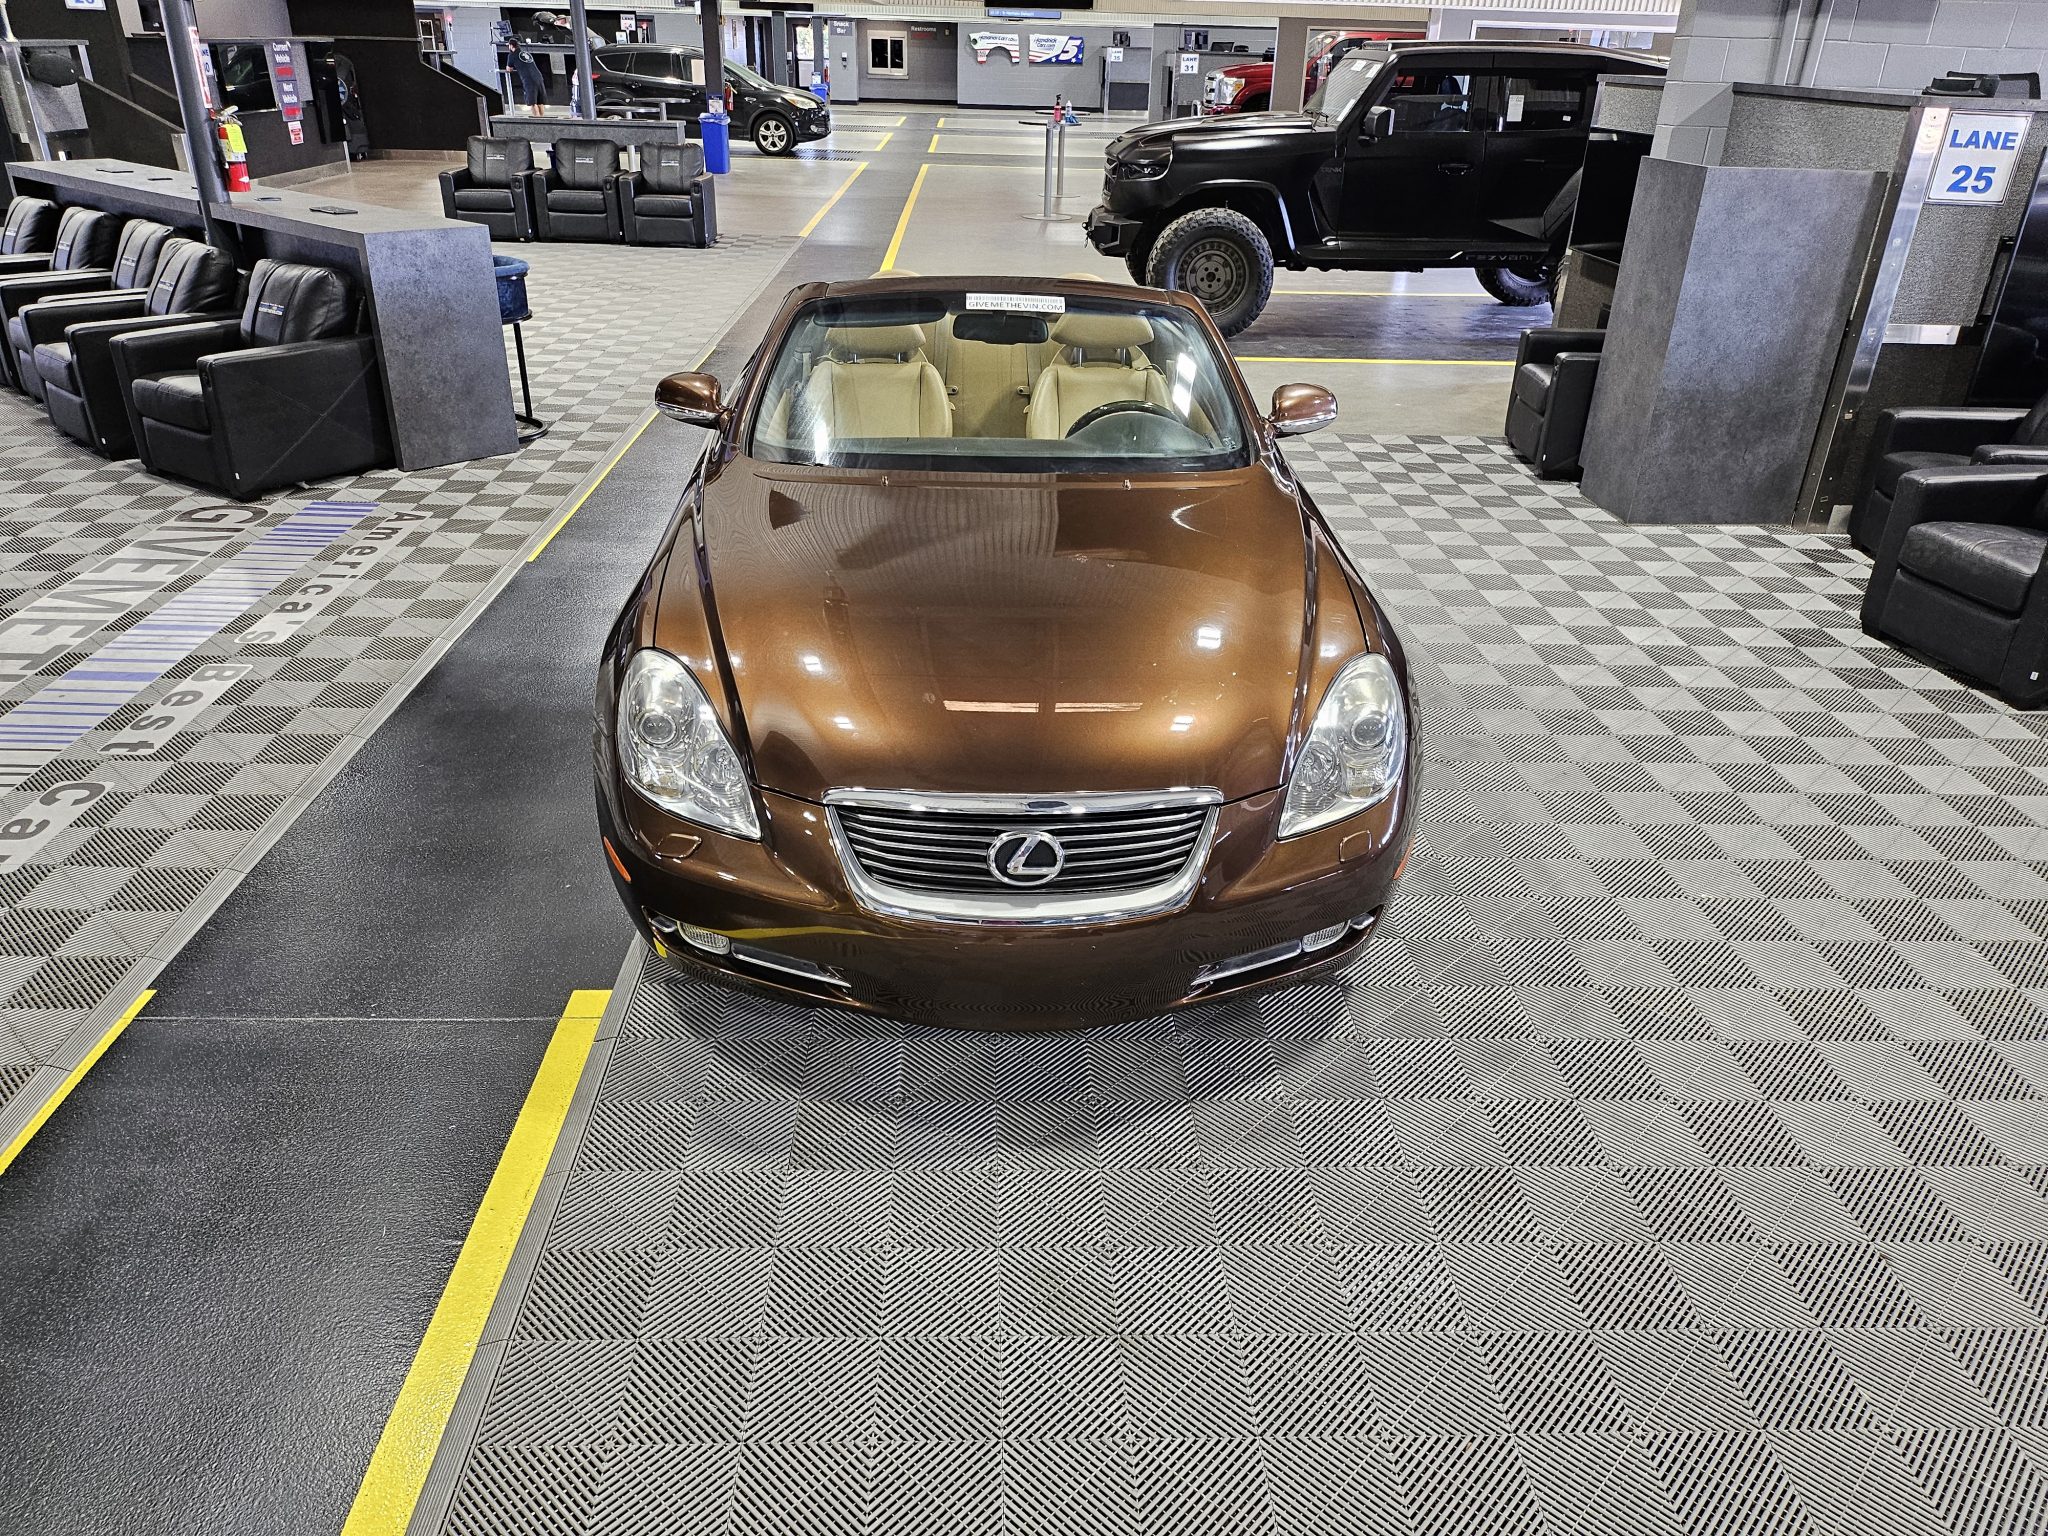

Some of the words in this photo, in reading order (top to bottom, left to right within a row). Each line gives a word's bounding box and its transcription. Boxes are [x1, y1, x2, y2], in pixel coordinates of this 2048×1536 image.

[1058, 39, 1083, 60] 5
[1184, 64, 1194, 72] 31
[1949, 129, 2019, 151] LANE
[1946, 164, 1997, 194] 25
[968, 301, 1063, 311] GIVEMETHEVIN.COM
[242, 510, 426, 643] America's
[100, 664, 244, 754] Best
[0, 782, 107, 868] Ca
